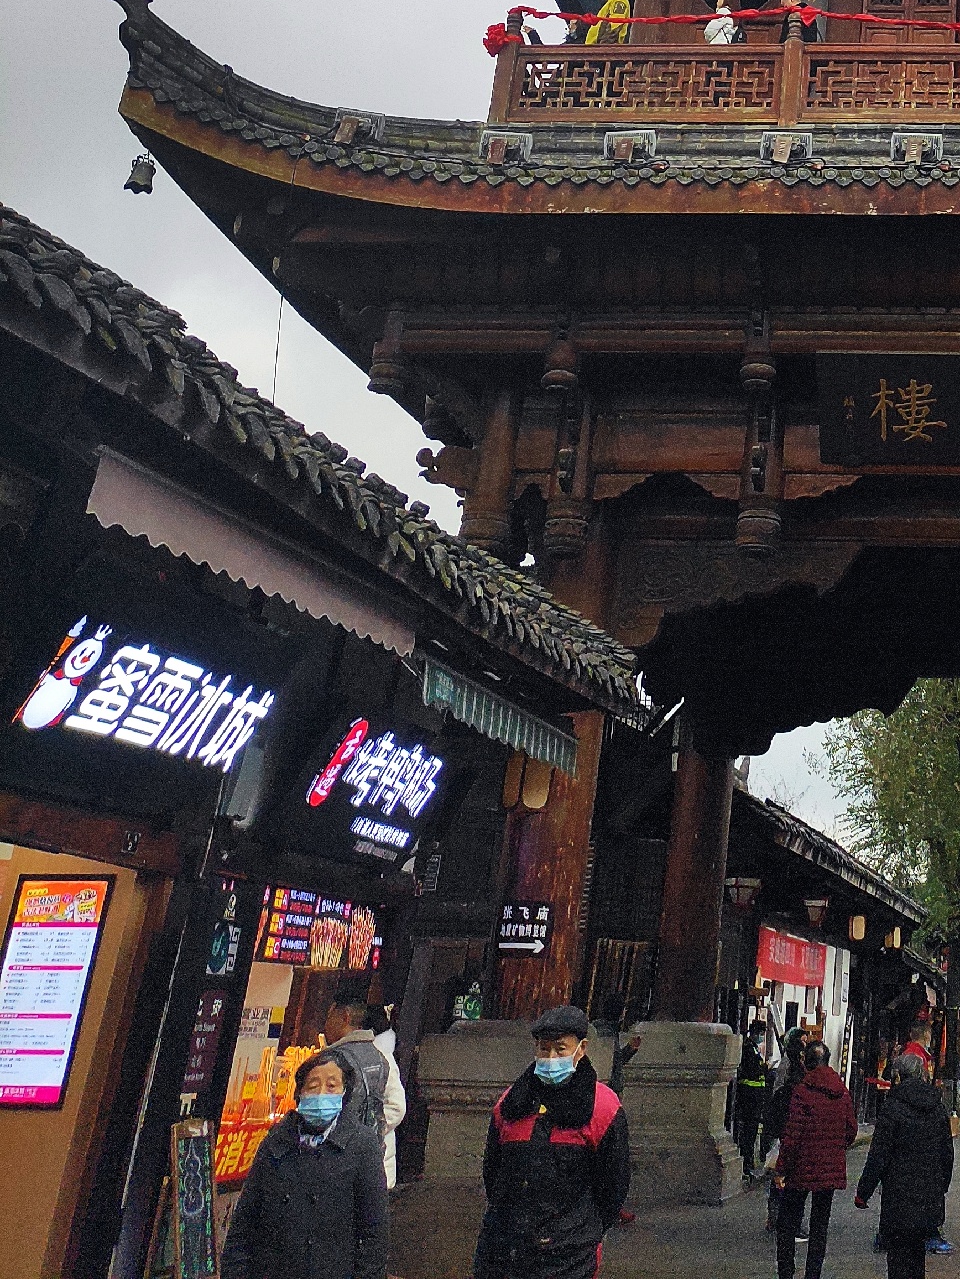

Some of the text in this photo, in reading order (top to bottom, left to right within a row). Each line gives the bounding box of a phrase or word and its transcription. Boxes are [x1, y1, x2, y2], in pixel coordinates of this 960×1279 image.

[64, 643, 275, 773] 蜜雪冰城
[502, 905, 550, 921] 张飞庙
